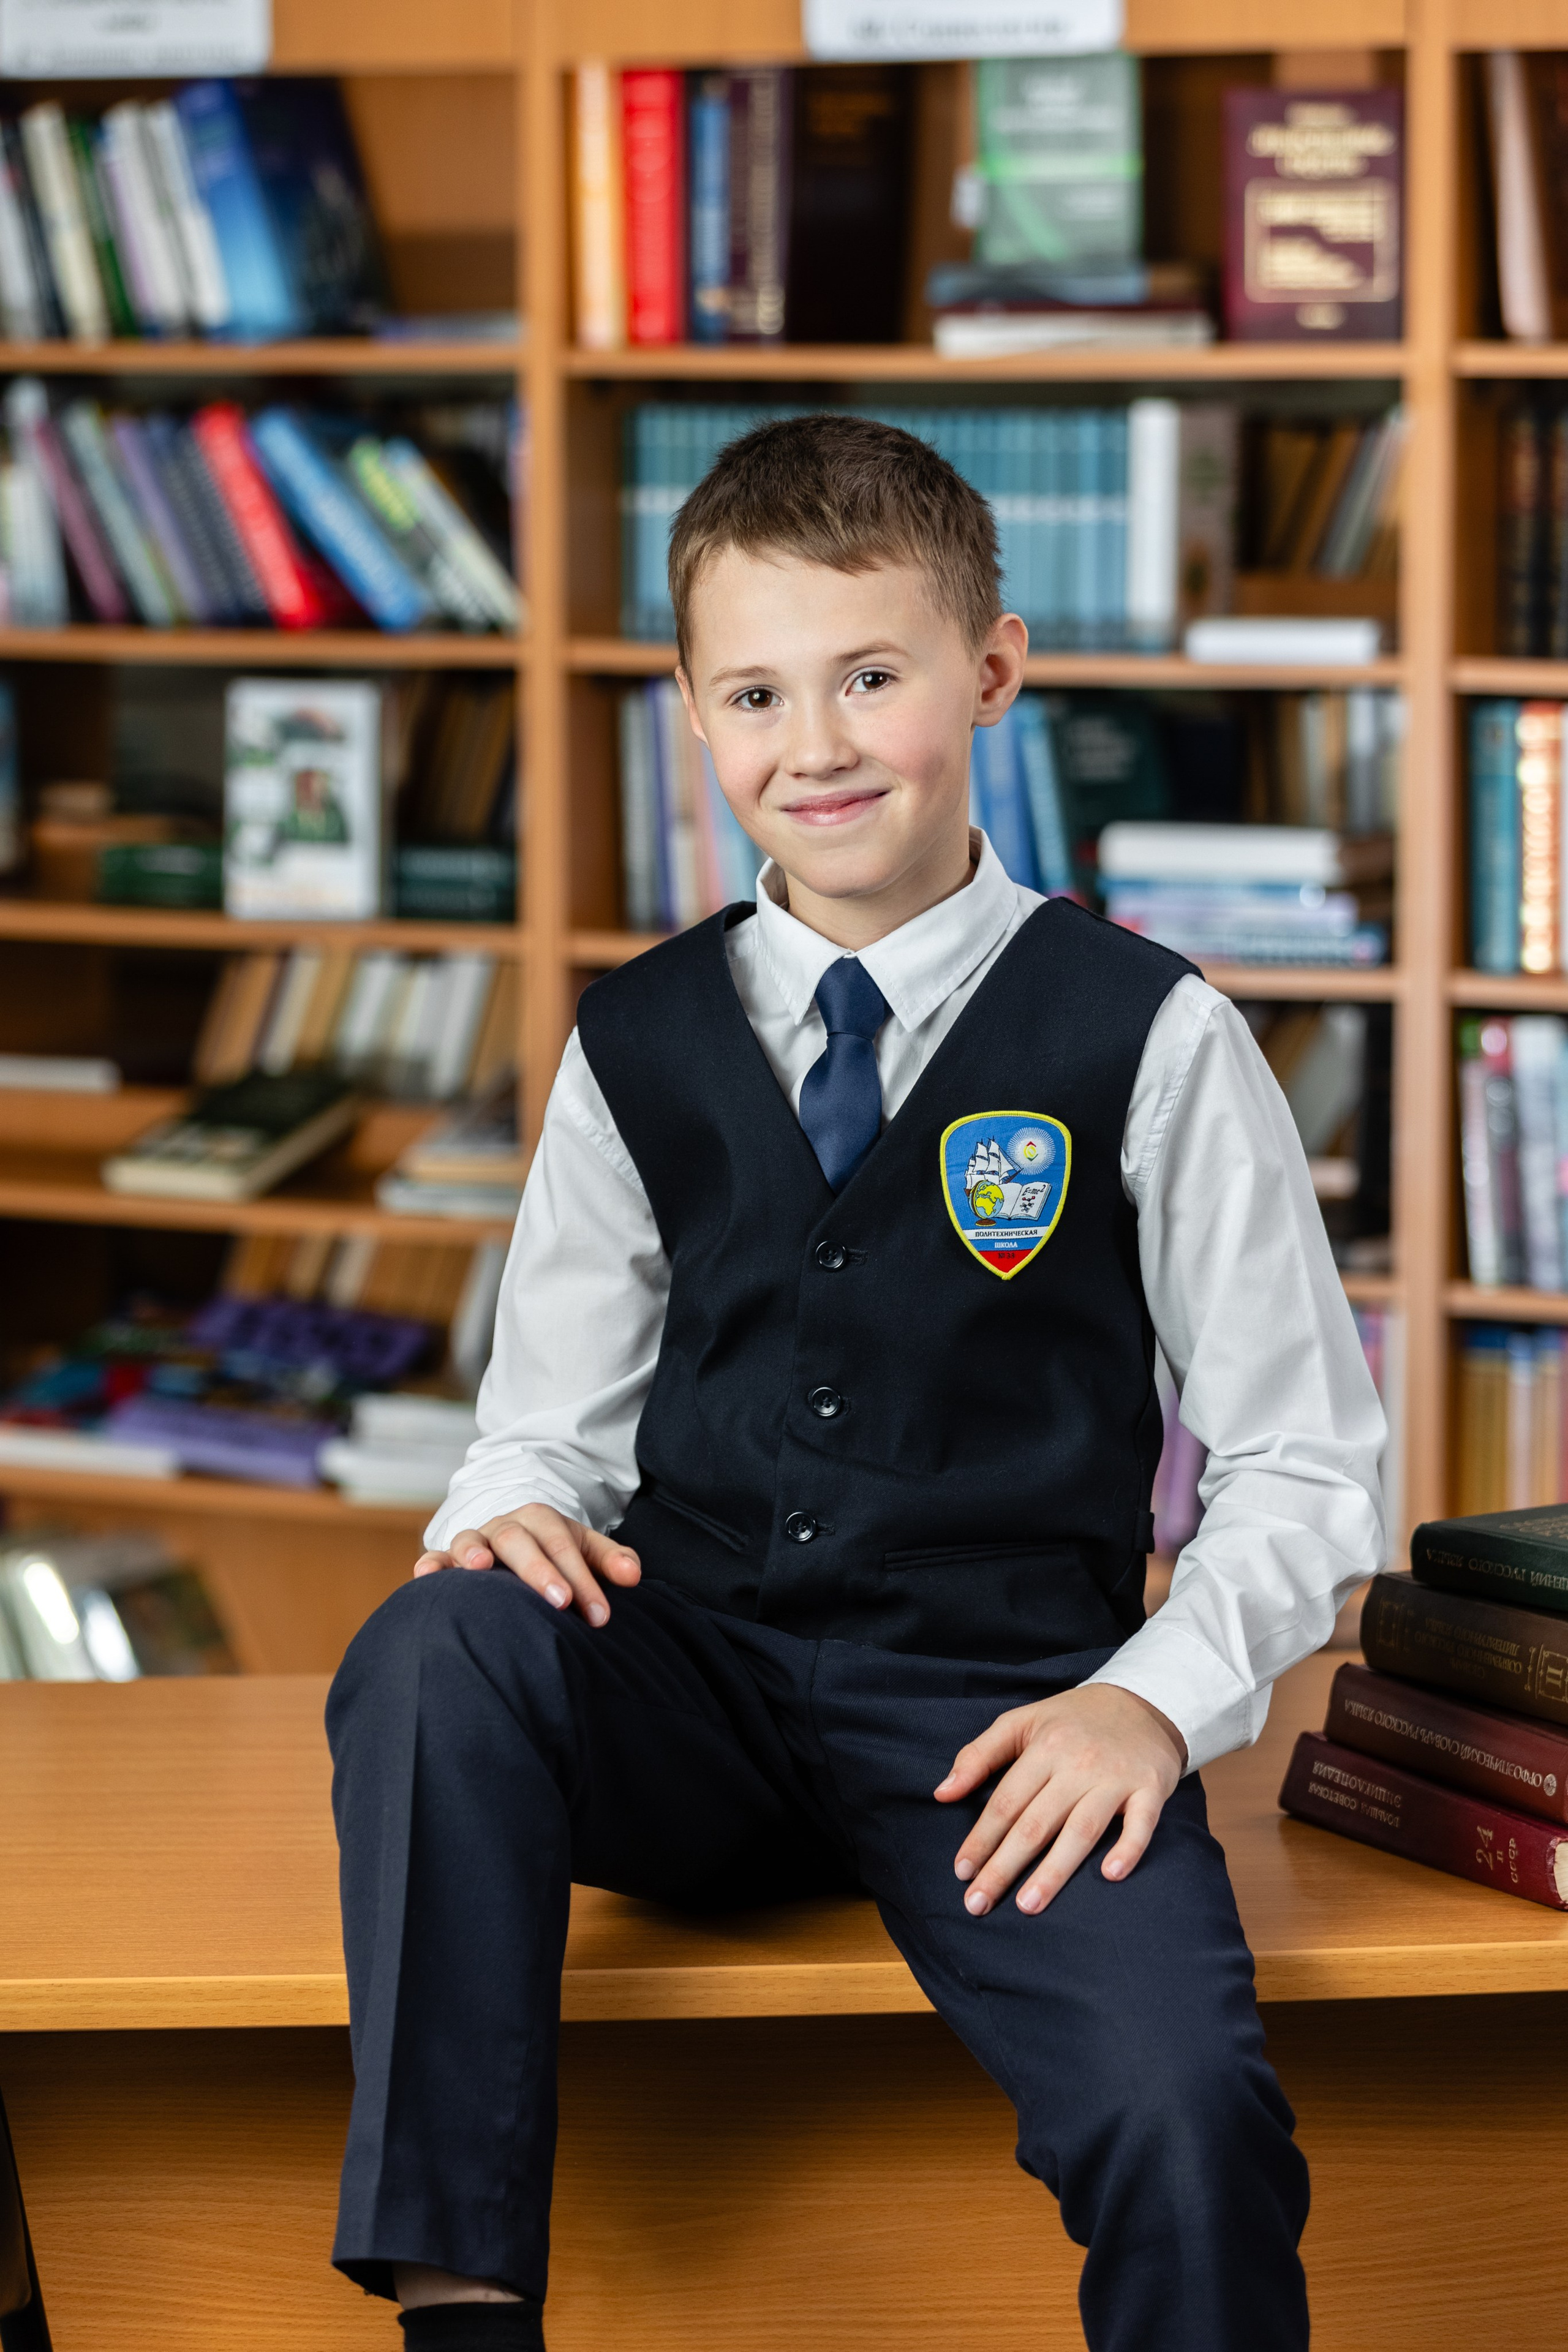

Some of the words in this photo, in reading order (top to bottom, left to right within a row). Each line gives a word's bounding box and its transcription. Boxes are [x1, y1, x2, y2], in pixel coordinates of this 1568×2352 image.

[1468, 1558, 1526, 1581] РУССКОГО
[1453, 1626, 1521, 1656] ЛИТЕРАТУРНОГО
[1457, 1644, 1522, 1675] СОВРЕМЕННОГО
[1344, 1699, 1375, 1722] ЯЗЫКА
[1374, 1709, 1420, 1740] РУССКОГО
[1420, 1728, 1460, 1755] СЛОВАРЬ
[1460, 1744, 1543, 1788] ОРФОЭПИЧЕСКИЙ
[1308, 1782, 1357, 1810] СОВЕТСКАЯ
[1312, 1761, 1401, 1808] ЭНЦИКЛОПЕДИЯ
[1360, 1802, 1400, 1828] БОЛЬШАЯ
[1476, 1825, 1493, 1871] 24
[1508, 1838, 1518, 1883] СССР
